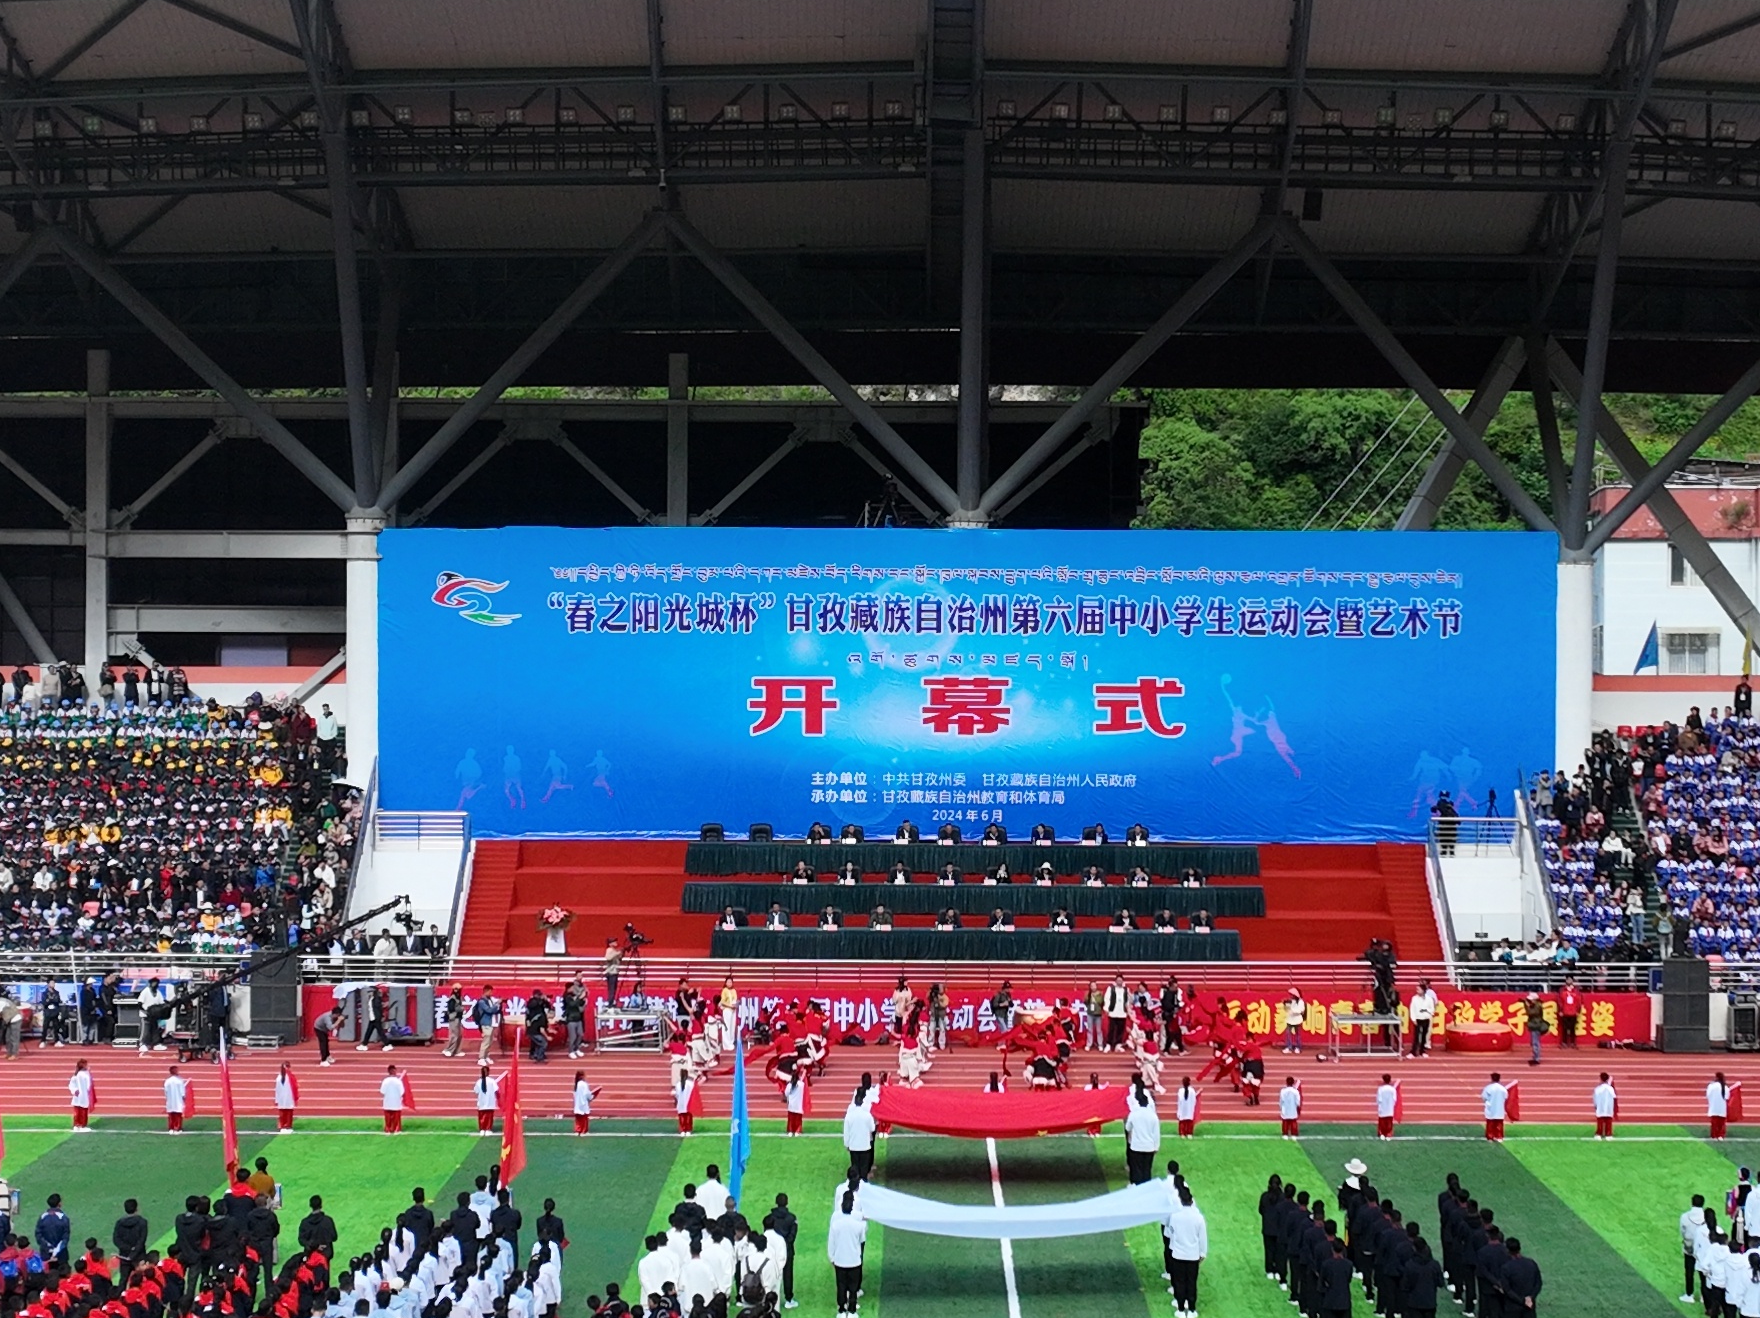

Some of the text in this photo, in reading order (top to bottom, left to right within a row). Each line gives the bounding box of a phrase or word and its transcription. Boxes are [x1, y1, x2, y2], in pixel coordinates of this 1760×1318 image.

[748, 676, 1185, 738] 开幕式
[982, 772, 1137, 788] 甘孜藏族自治州人民政府
